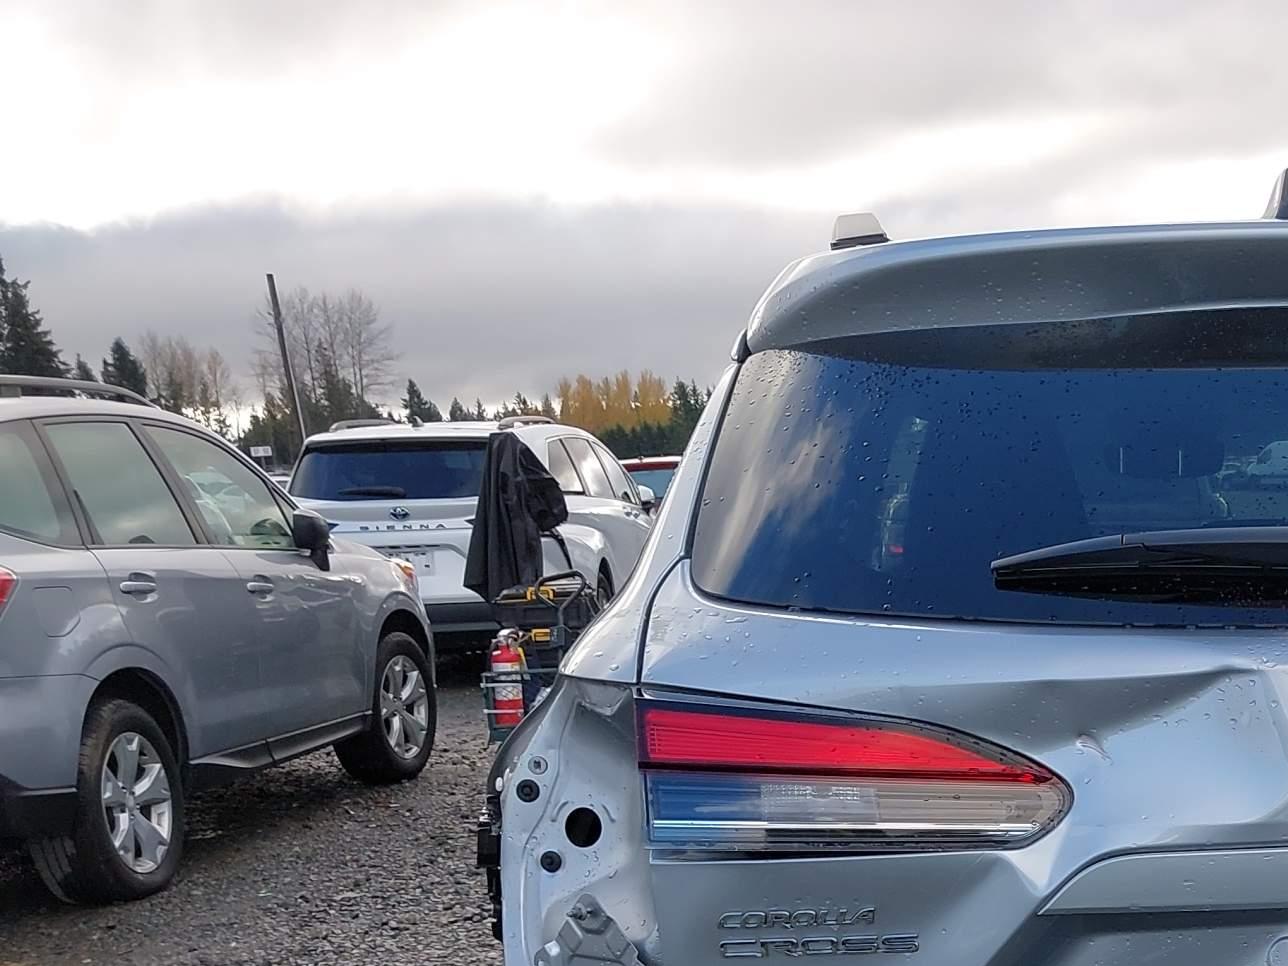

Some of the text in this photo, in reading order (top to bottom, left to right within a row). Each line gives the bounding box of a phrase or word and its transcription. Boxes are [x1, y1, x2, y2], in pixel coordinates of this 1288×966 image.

[359, 523, 447, 531] SIENNA
[718, 907, 876, 929] COROLLA
[719, 934, 920, 958] CROSS
